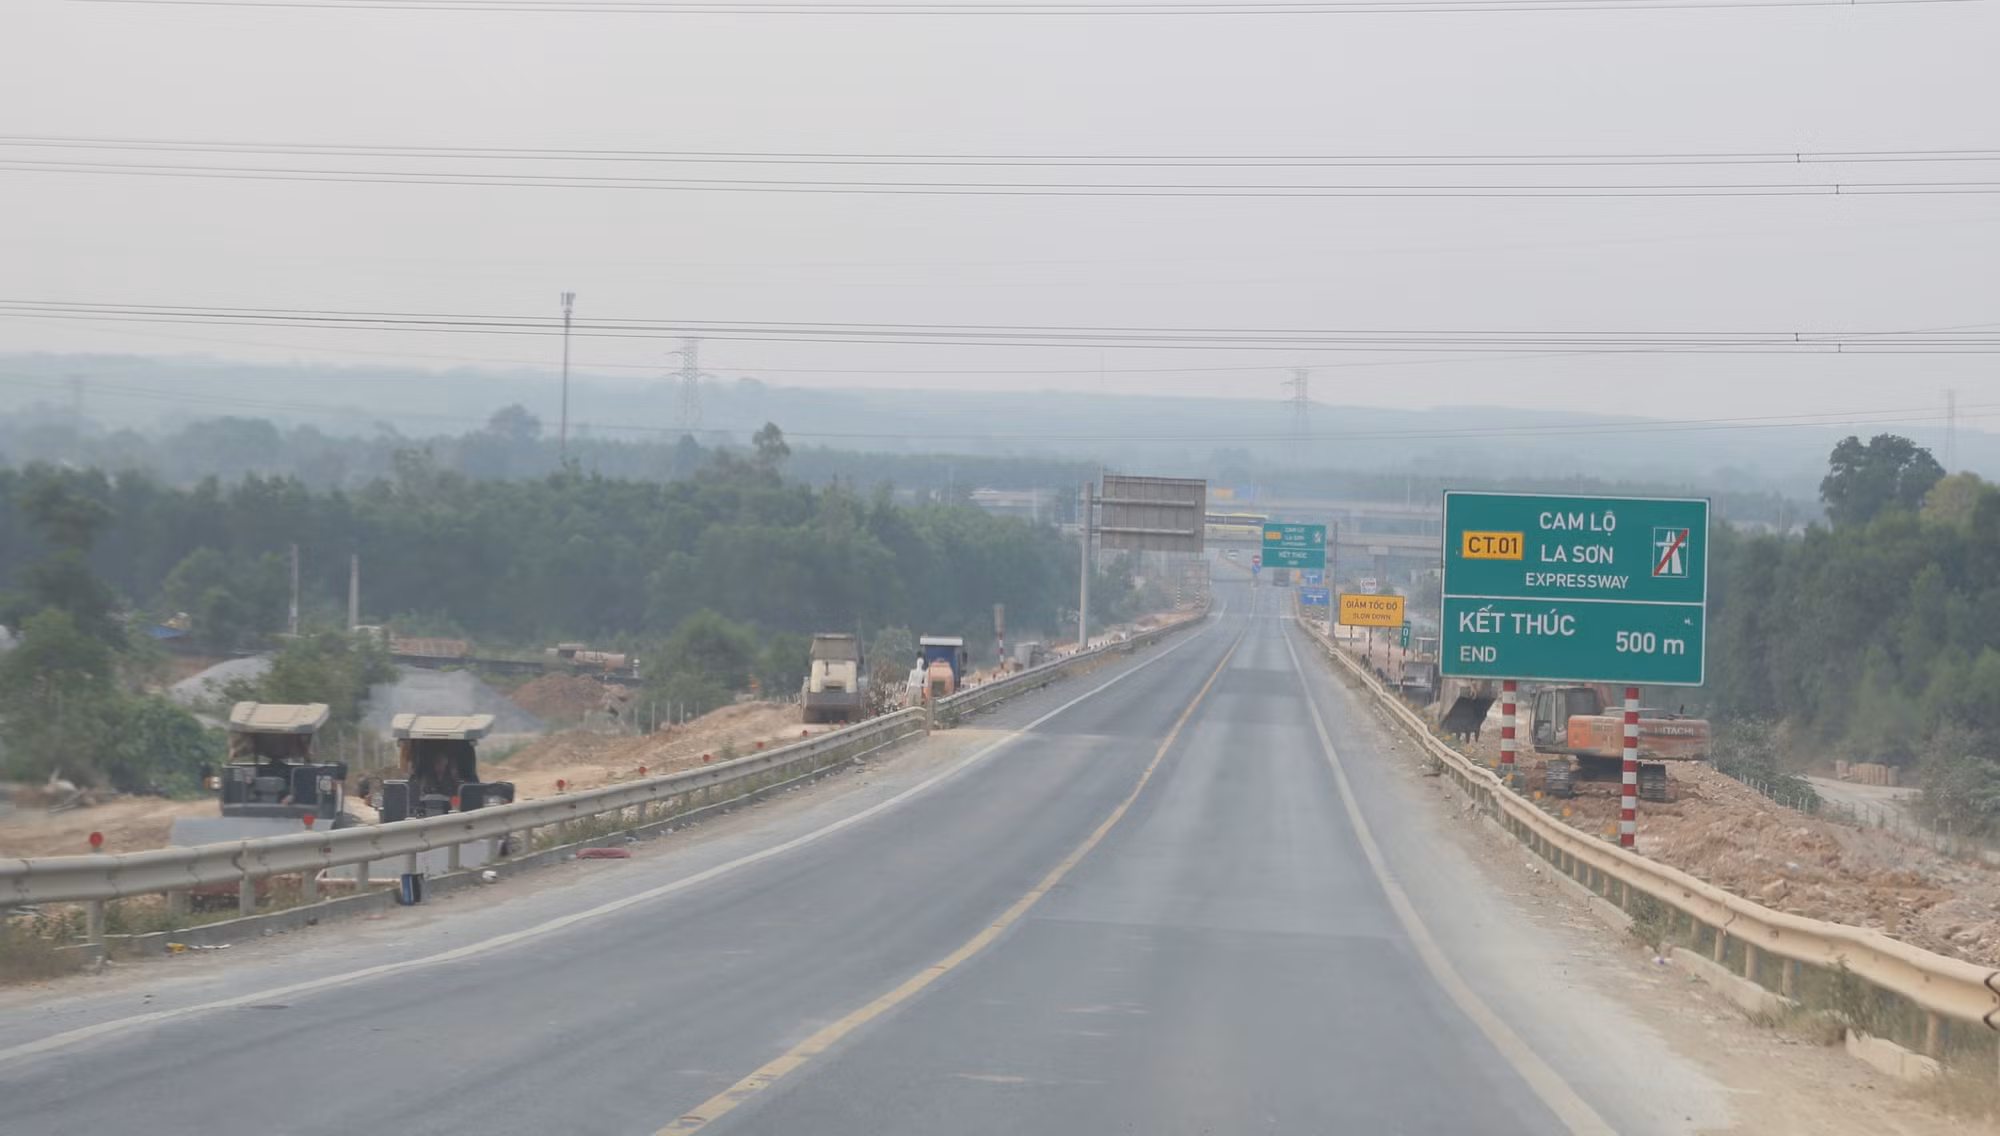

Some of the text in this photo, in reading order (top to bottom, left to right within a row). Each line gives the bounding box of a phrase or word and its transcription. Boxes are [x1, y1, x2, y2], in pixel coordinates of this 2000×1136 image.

[1540, 509, 1616, 536] CAM LỘ
[1468, 536, 1518, 555] CT.01
[1541, 544, 1614, 564] LA SƠN
[1525, 572, 1629, 589] EXPRESSWAY
[1372, 613, 1391, 621] DOWN
[1459, 604, 1576, 636] KẾT THÚC
[1616, 631, 1685, 655] 500 m
[1460, 645, 1497, 663] END
[1654, 726, 1694, 736] HITACHI
